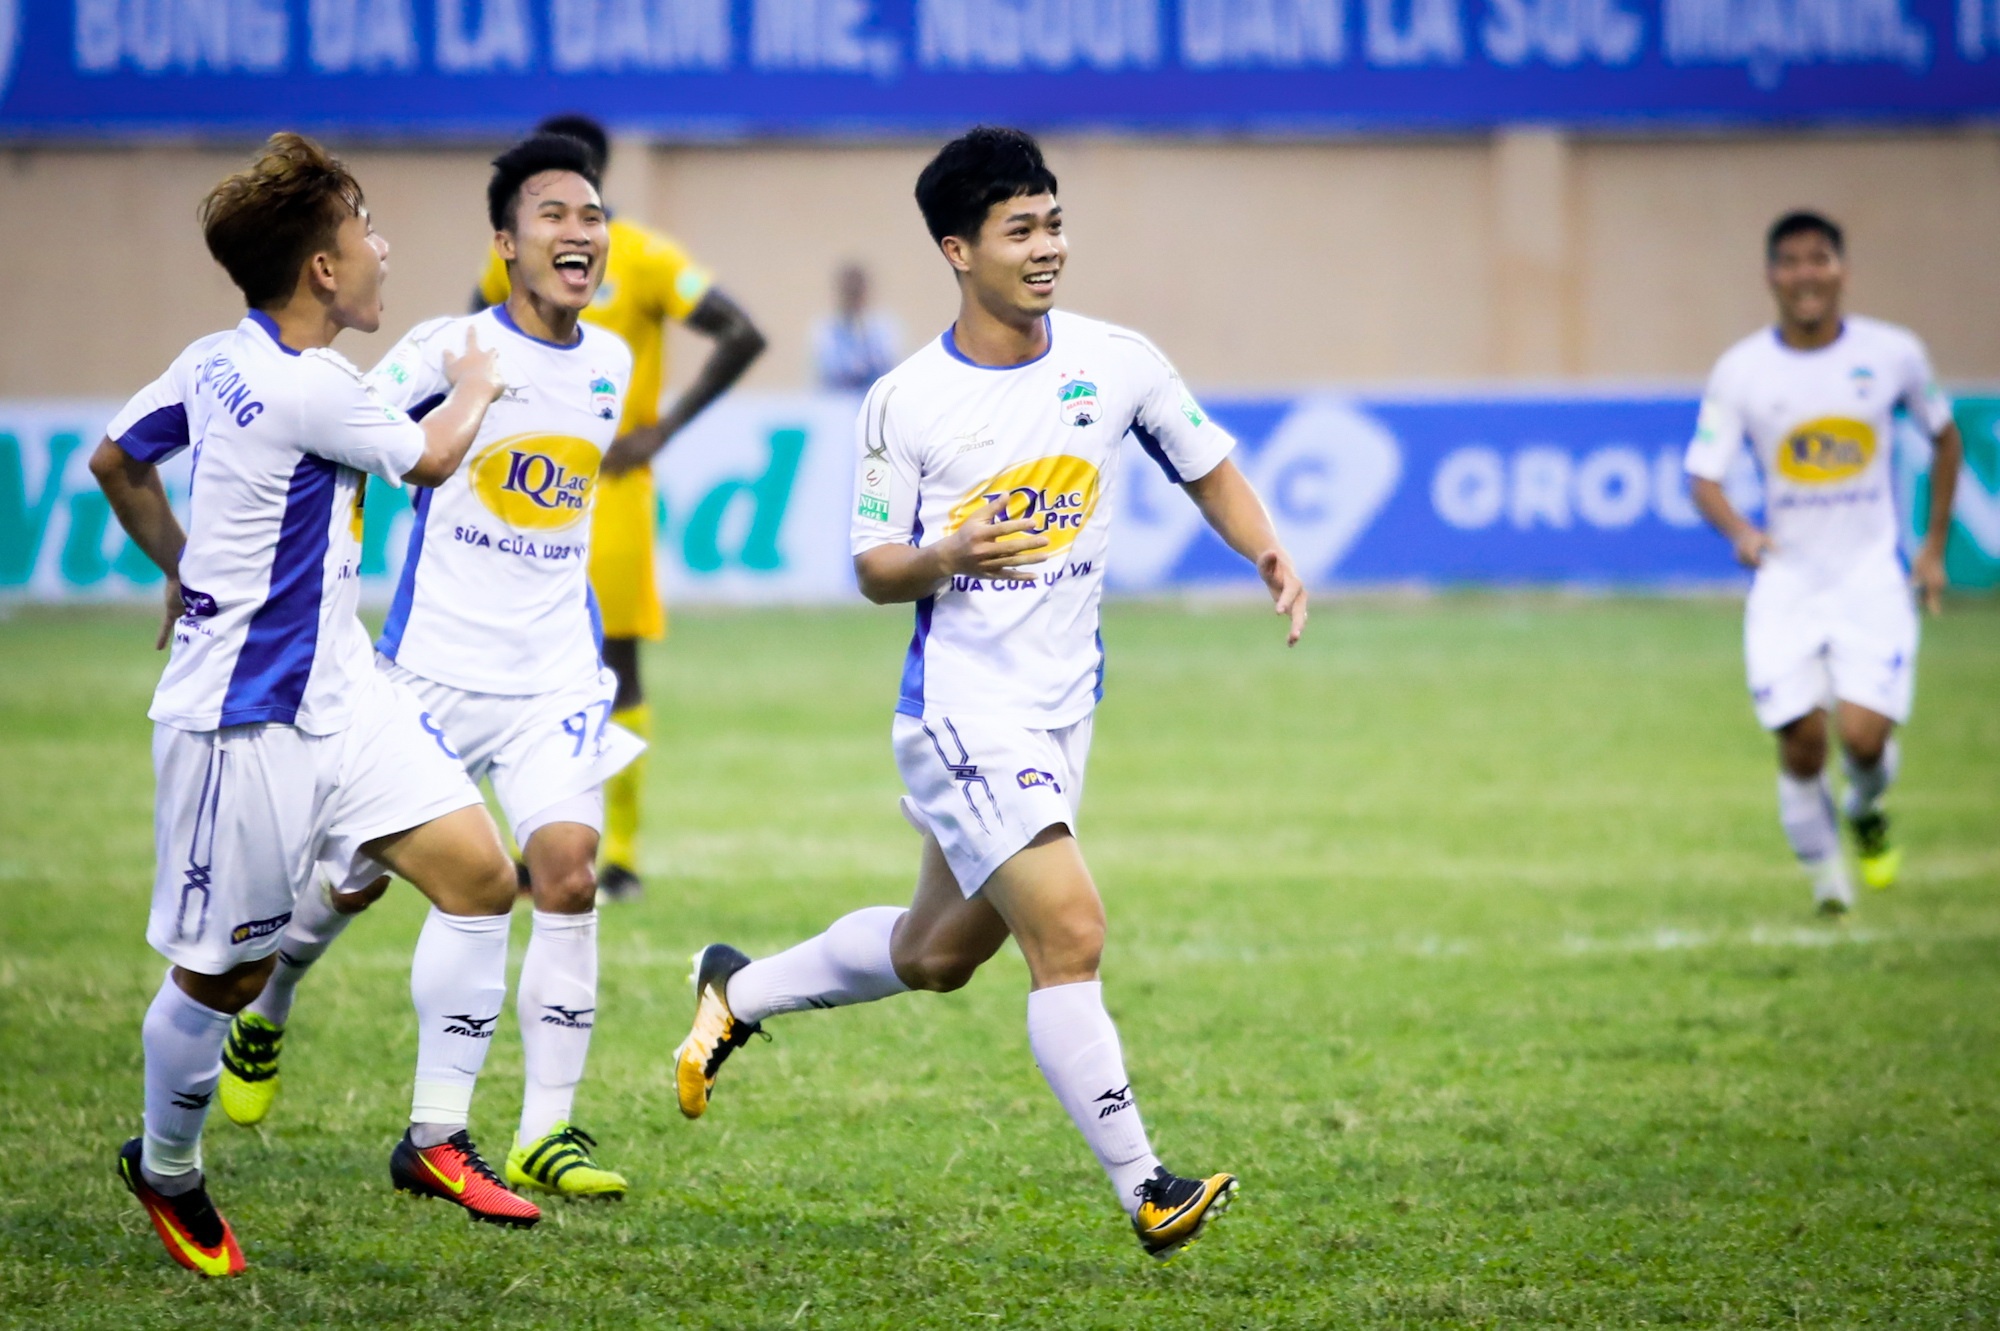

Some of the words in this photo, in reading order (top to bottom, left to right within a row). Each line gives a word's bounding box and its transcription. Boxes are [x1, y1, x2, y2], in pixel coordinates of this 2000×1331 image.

[501, 450, 556, 508] IQ
[554, 466, 588, 491] Lac
[554, 490, 583, 509] Pro
[1037, 489, 1082, 512] Lac
